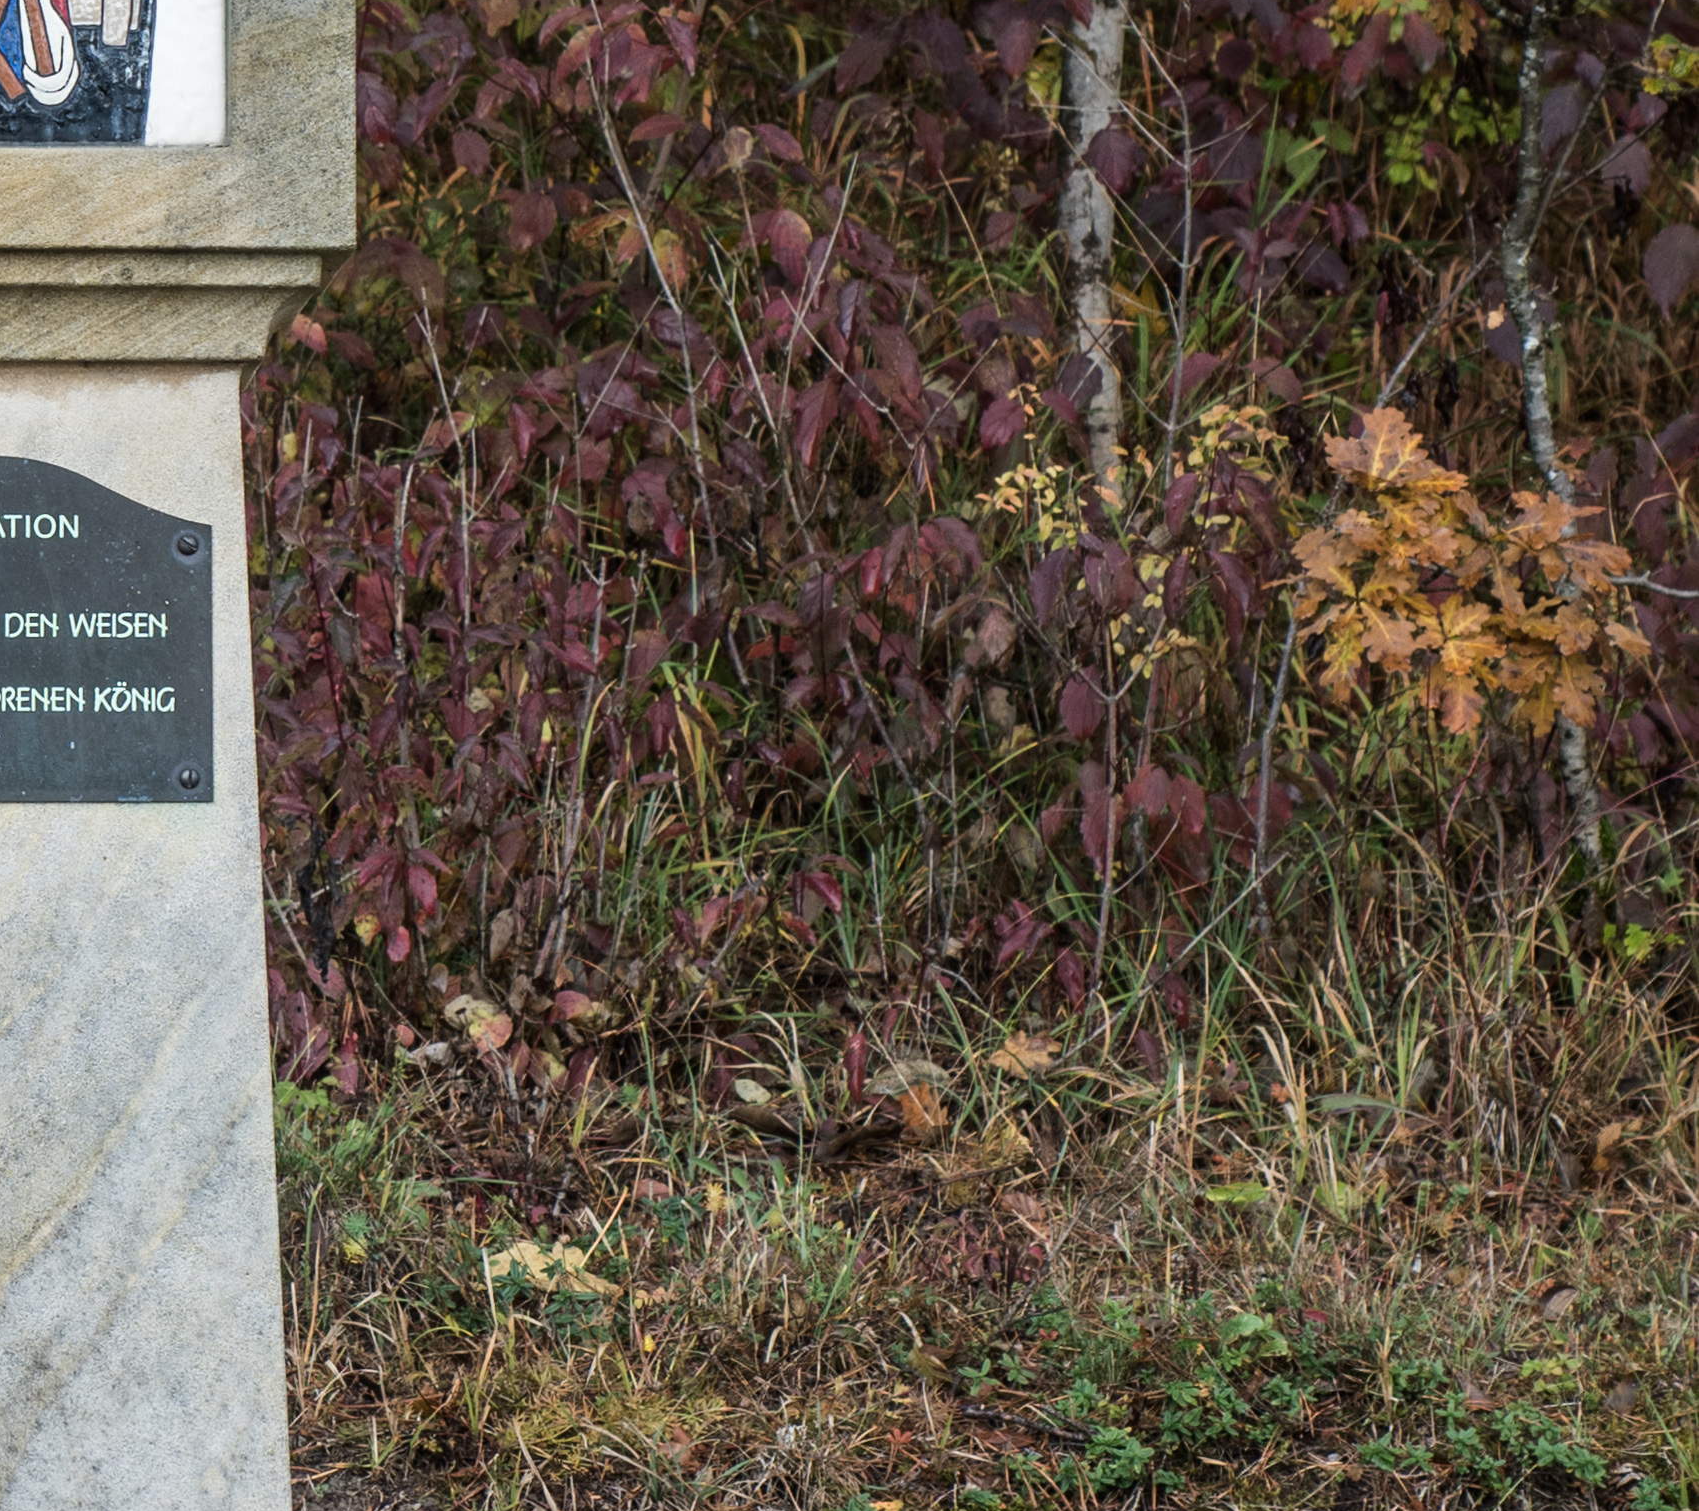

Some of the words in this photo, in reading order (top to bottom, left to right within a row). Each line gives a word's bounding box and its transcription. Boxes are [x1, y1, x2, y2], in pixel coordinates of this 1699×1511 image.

[4, 612, 60, 639] DEN
[69, 611, 169, 639] WEISEN
[93, 680, 176, 713] KÖNIG
